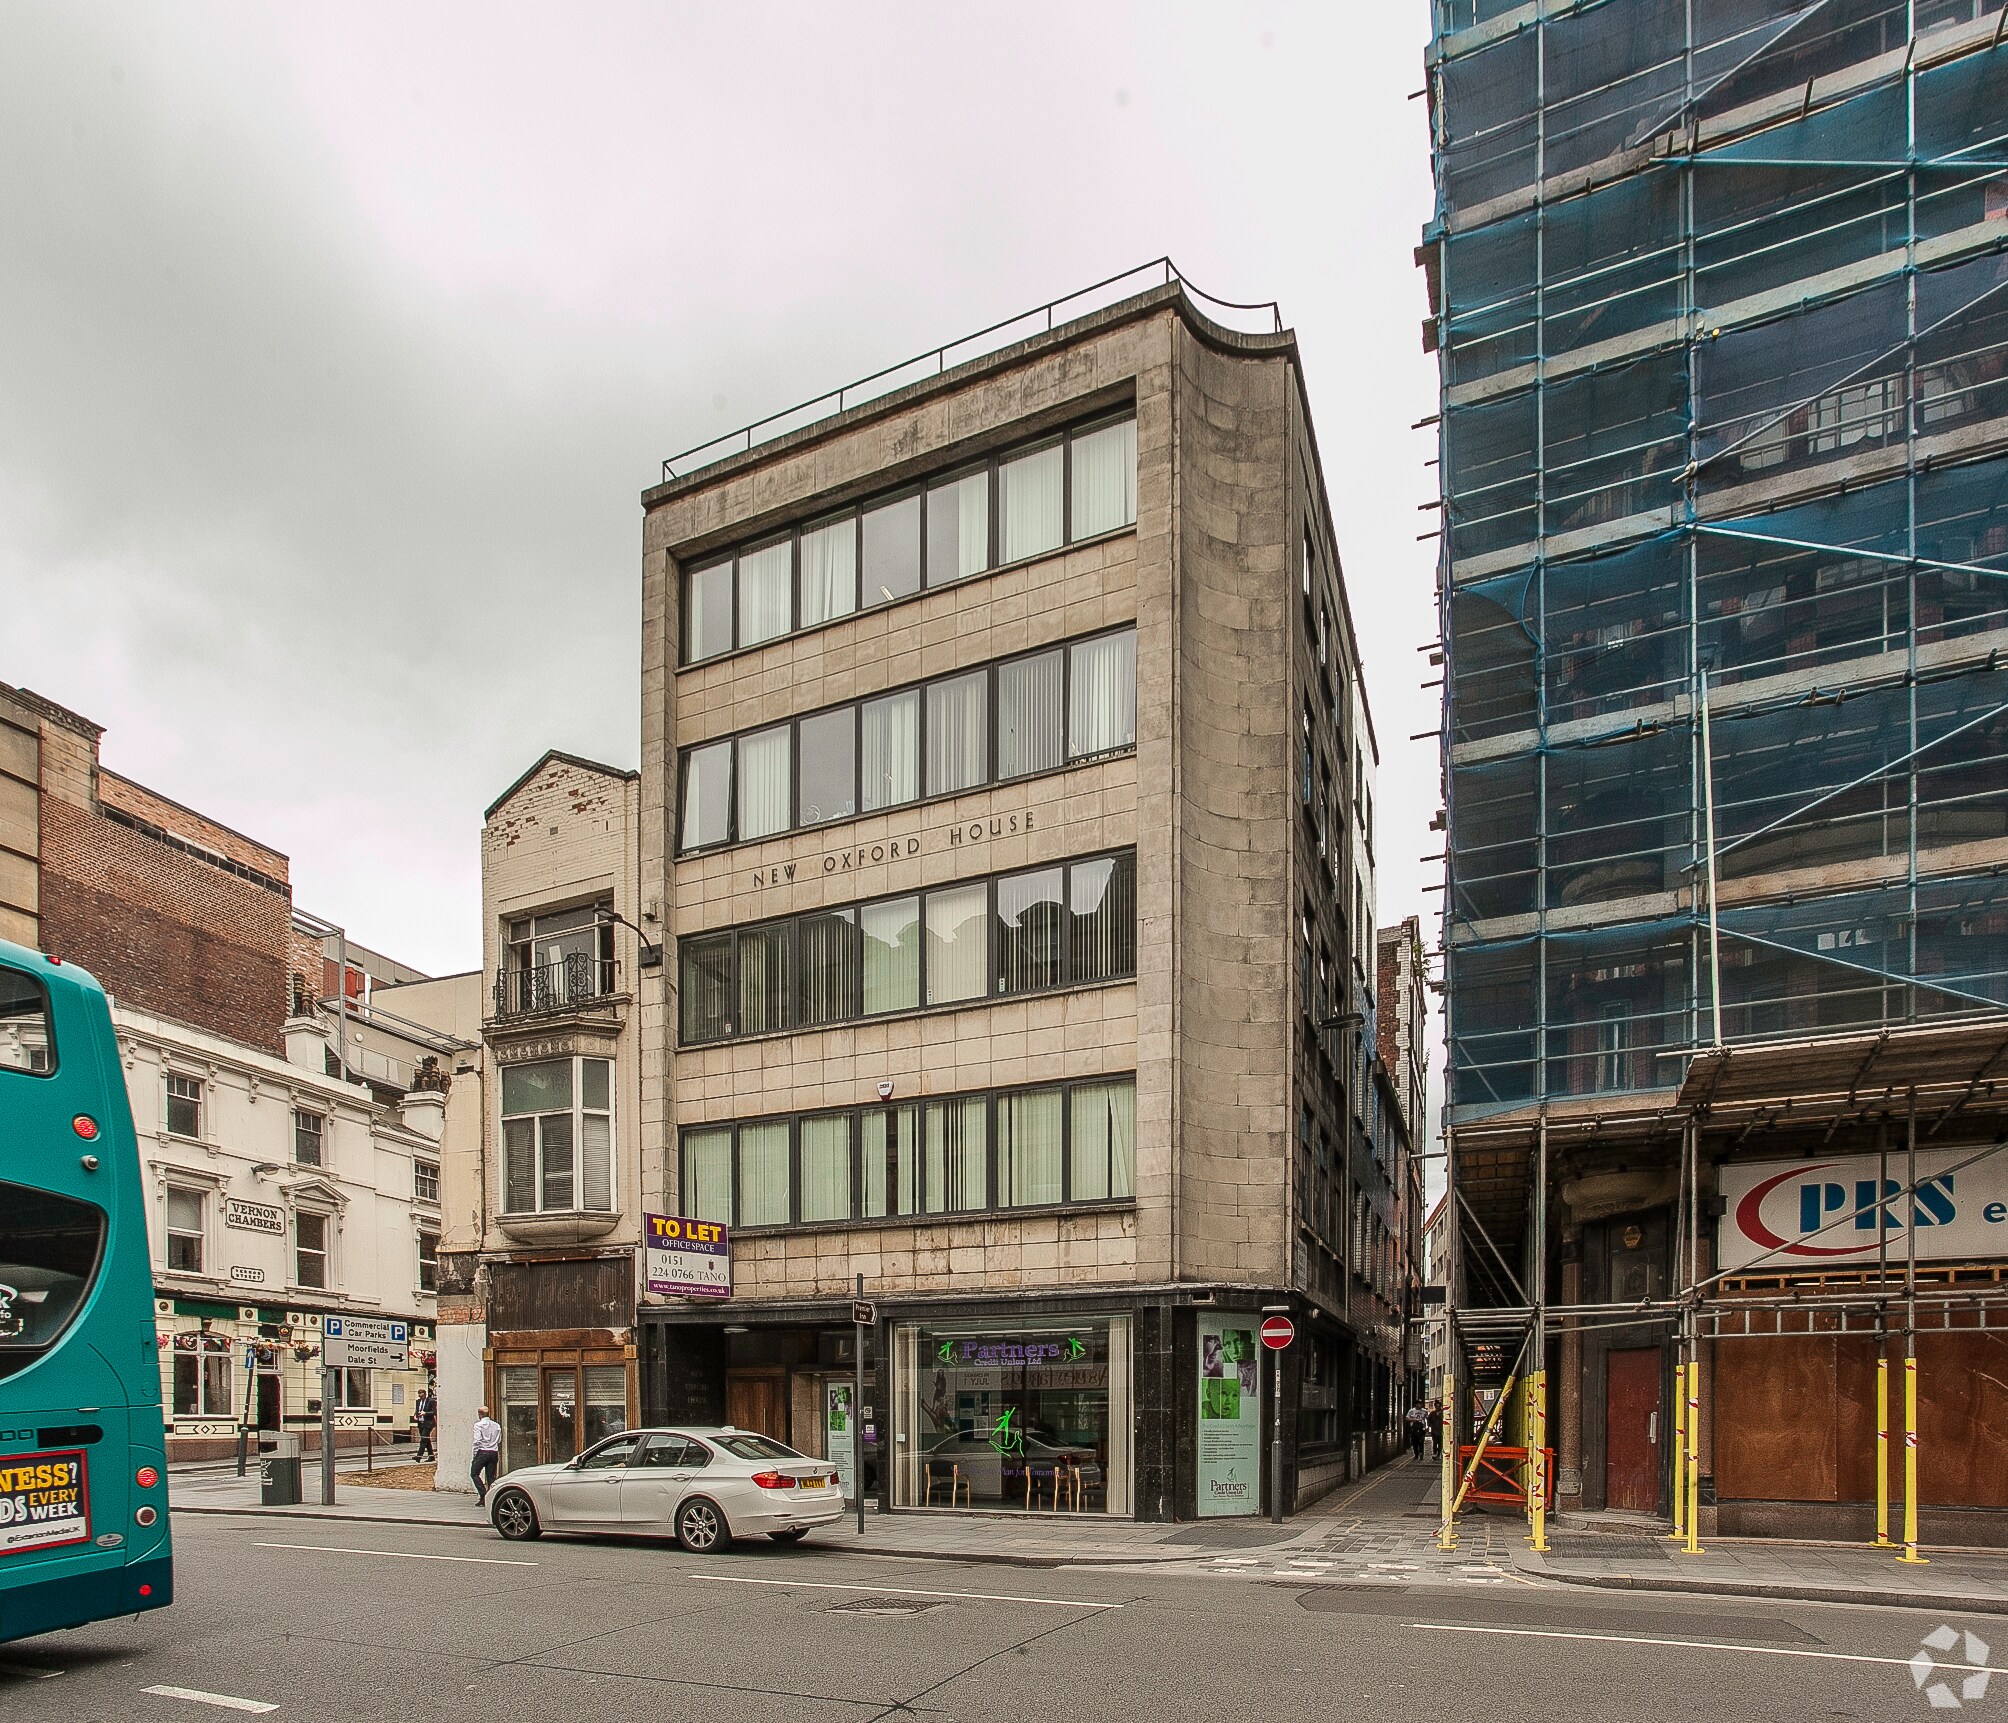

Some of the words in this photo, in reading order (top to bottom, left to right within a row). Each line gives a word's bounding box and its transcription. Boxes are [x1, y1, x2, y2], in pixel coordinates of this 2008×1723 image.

[753, 863, 797, 887] NEW
[823, 838, 920, 872] OXFORD
[950, 811, 1034, 846] HOUSE
[1800, 1174, 1956, 1233] PRS
[231, 1203, 278, 1220] VERNON
[228, 1213, 282, 1231] CHAMBERS
[652, 1217, 680, 1238] TO
[686, 1222, 722, 1243] LET
[662, 1239, 690, 1250] OFFICE
[691, 1242, 715, 1253] SPACE
[661, 1254, 683, 1266] 0151
[652, 1266, 669, 1278] 224
[671, 1268, 694, 1280] 0766
[697, 1270, 727, 1283] TANO
[653, 1283, 726, 1294] www.tanoproperties.co.uk
[330, 1321, 340, 1334] P
[344, 1319, 390, 1331] Commercial
[348, 1328, 362, 1337] Car
[365, 1330, 387, 1339] Parks
[394, 1326, 404, 1339] P
[347, 1343, 389, 1354] Moorfields
[962, 1341, 1060, 1359] Partners
[347, 1355, 366, 1364] Dale
[367, 1357, 377, 1365] St
[974, 1358, 999, 1367] Credit
[1000, 1358, 1026, 1366] Union
[1027, 1357, 1042, 1365] Ltd
[0, 1462, 78, 1492] NESS?
[1210, 1480, 1247, 1491] Partners
[29, 1487, 78, 1506] EVERY
[29, 1501, 79, 1520] WEEK
